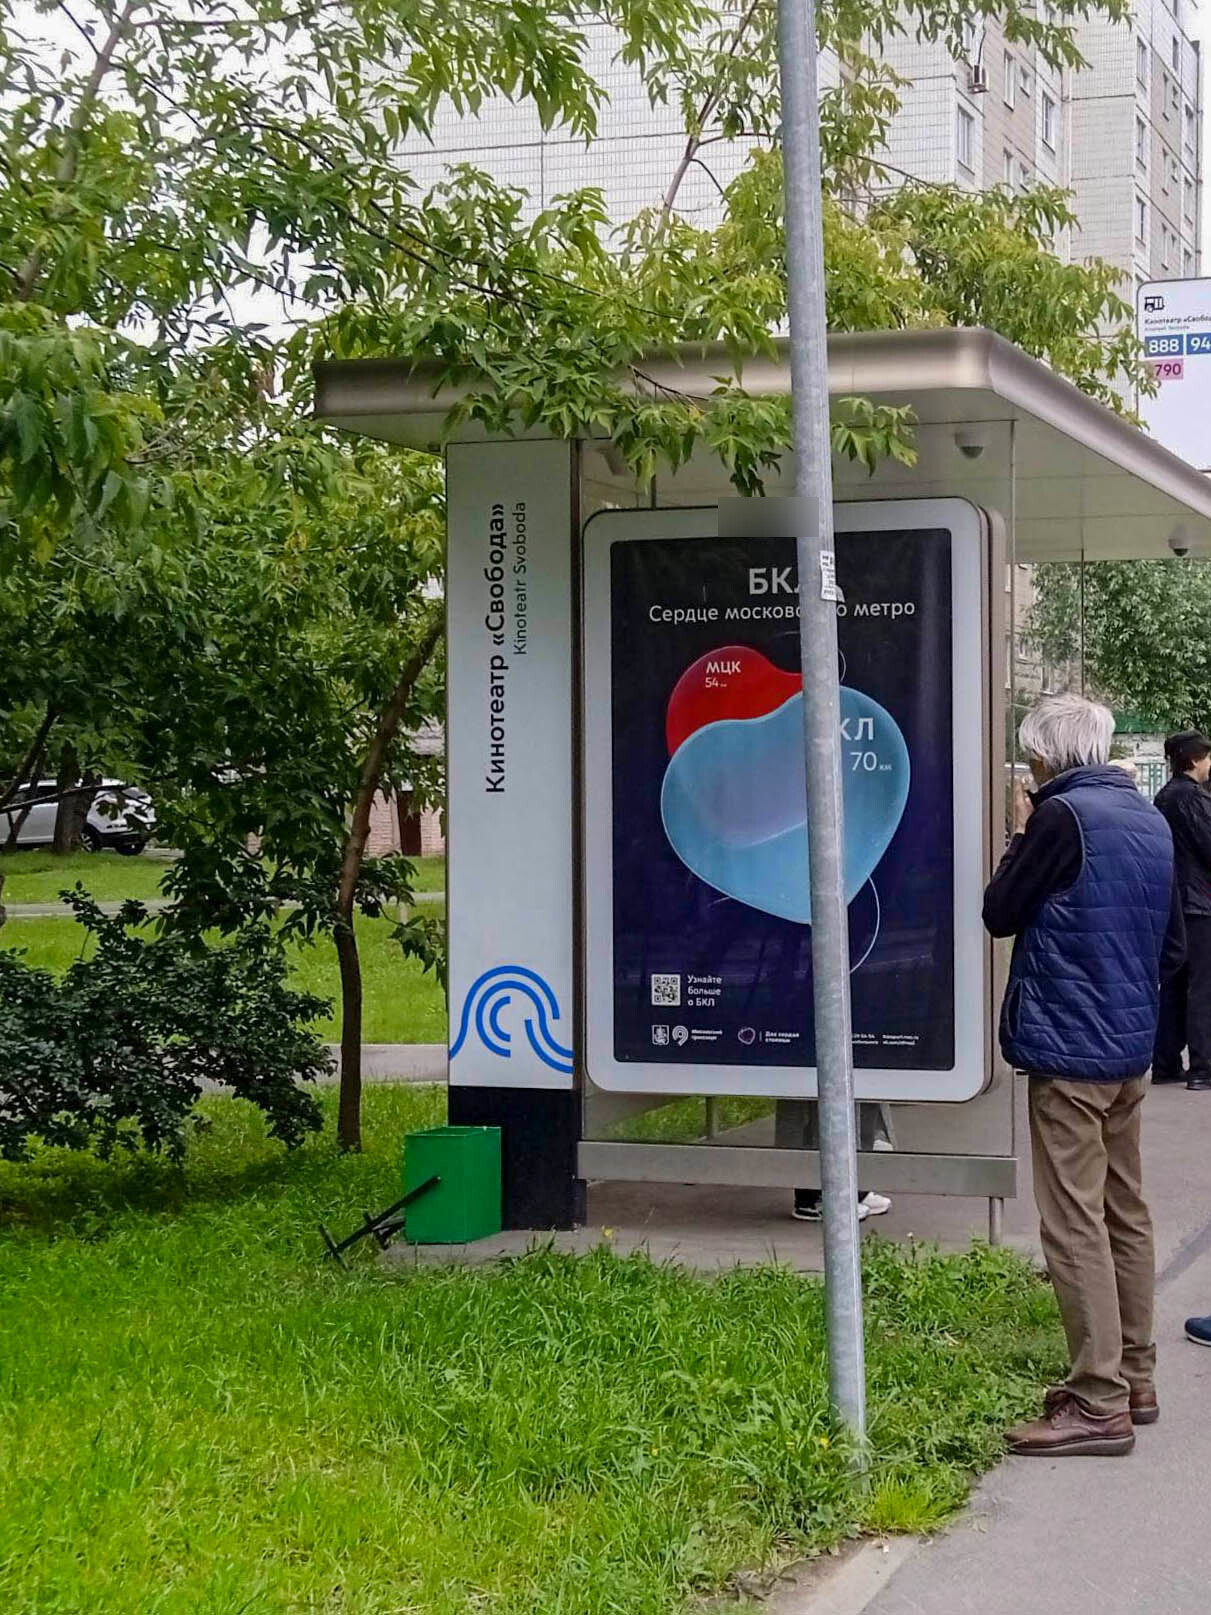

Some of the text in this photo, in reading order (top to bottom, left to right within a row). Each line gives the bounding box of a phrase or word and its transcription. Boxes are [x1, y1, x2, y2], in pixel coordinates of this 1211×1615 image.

[1149, 339, 1179, 353] 888
[1155, 363, 1181, 377] 790
[512, 502, 527, 655] Kinoteatr Svoboda
[749, 567, 799, 595] БК
[649, 600, 915, 624] Сердце московсо метро
[485, 504, 509, 793] Кинотеатр «Свобода»
[705, 660, 741, 676] МЦК
[705, 676, 719, 688] 54
[840, 717, 874, 741] КЛ
[850, 751, 877, 771] 70
[687, 974, 722, 984] Узнайте
[687, 986, 722, 996] больше
[696, 998, 715, 1007] БКЛ
